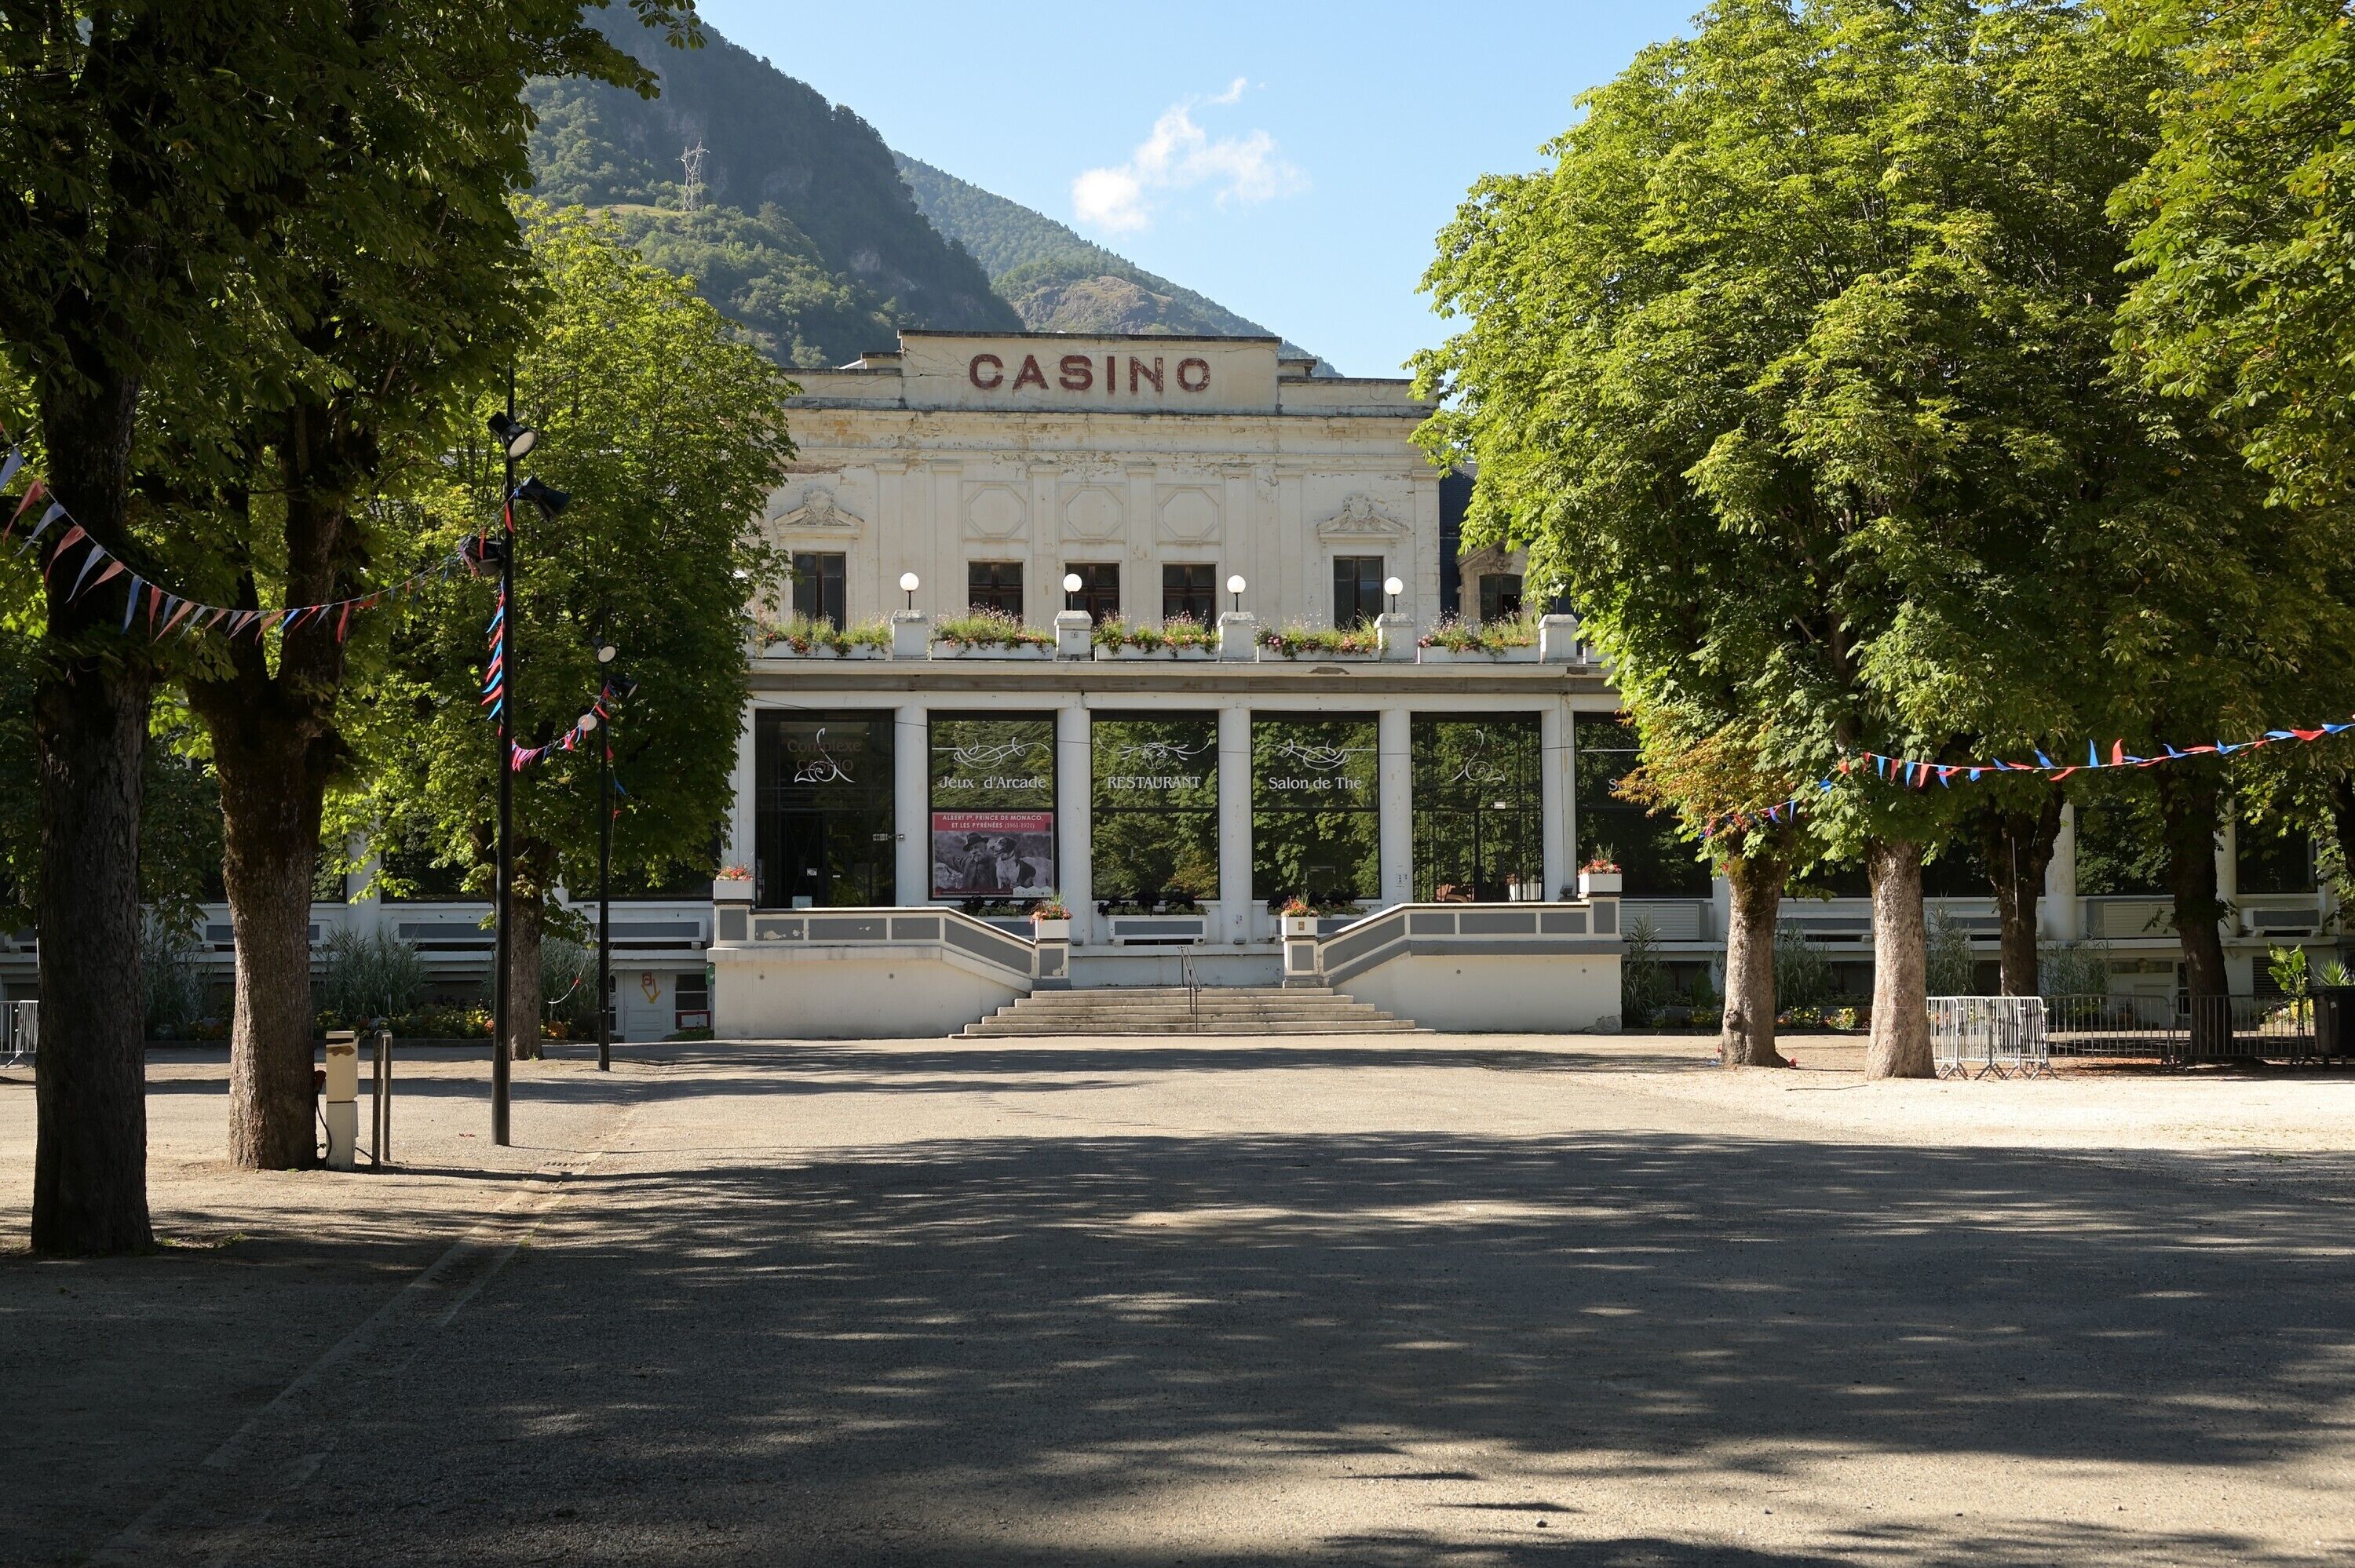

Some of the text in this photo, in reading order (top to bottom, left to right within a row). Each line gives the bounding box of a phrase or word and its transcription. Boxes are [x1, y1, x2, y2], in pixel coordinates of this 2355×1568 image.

[969, 354, 1210, 392] CASINO
[787, 739, 862, 753] Complexe
[939, 775, 1047, 789] Jeux d'Arcade
[1108, 776, 1202, 789] RESTAURANT
[1269, 776, 1362, 789] Salon de Thé
